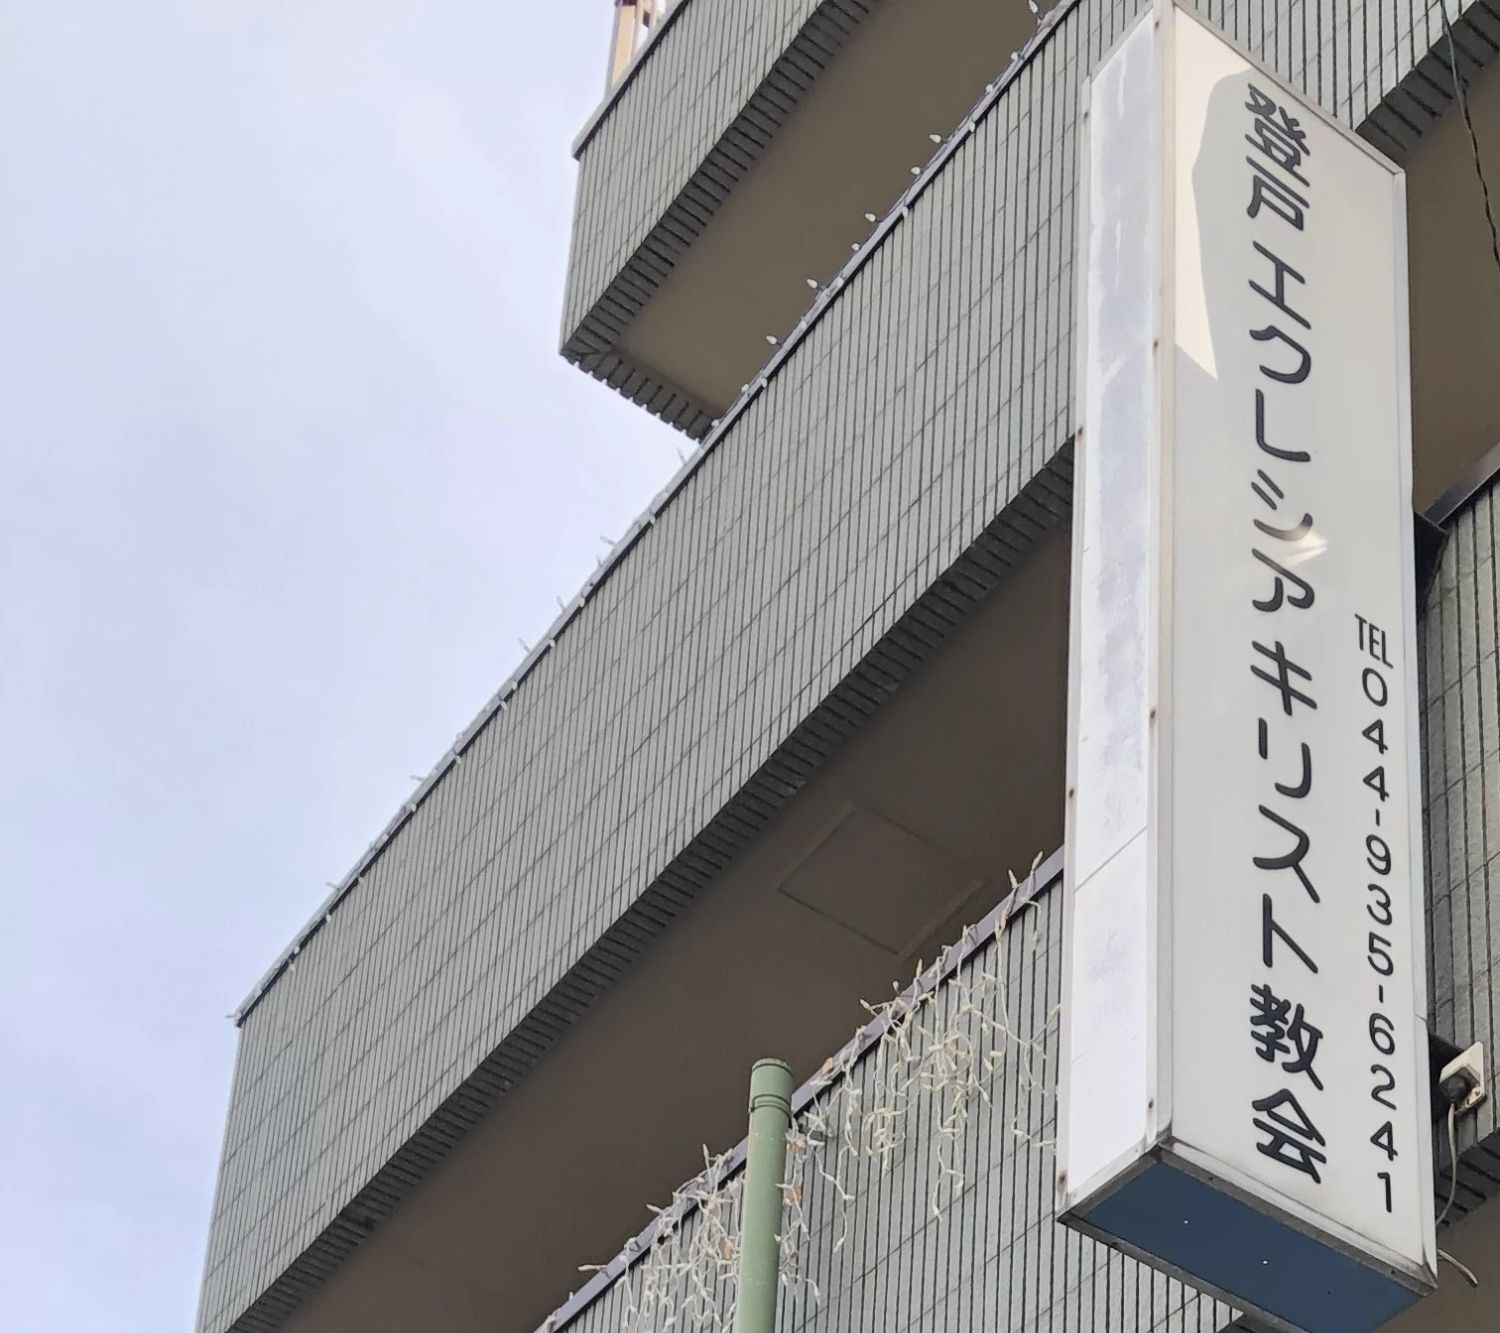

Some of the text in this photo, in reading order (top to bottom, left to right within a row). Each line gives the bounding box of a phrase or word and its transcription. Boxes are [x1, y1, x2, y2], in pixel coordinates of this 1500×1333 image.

[1244, 82, 1327, 1185] 登戸エクレシアキリスト教会
[1360, 667, 1398, 1213] 044-935-6241
